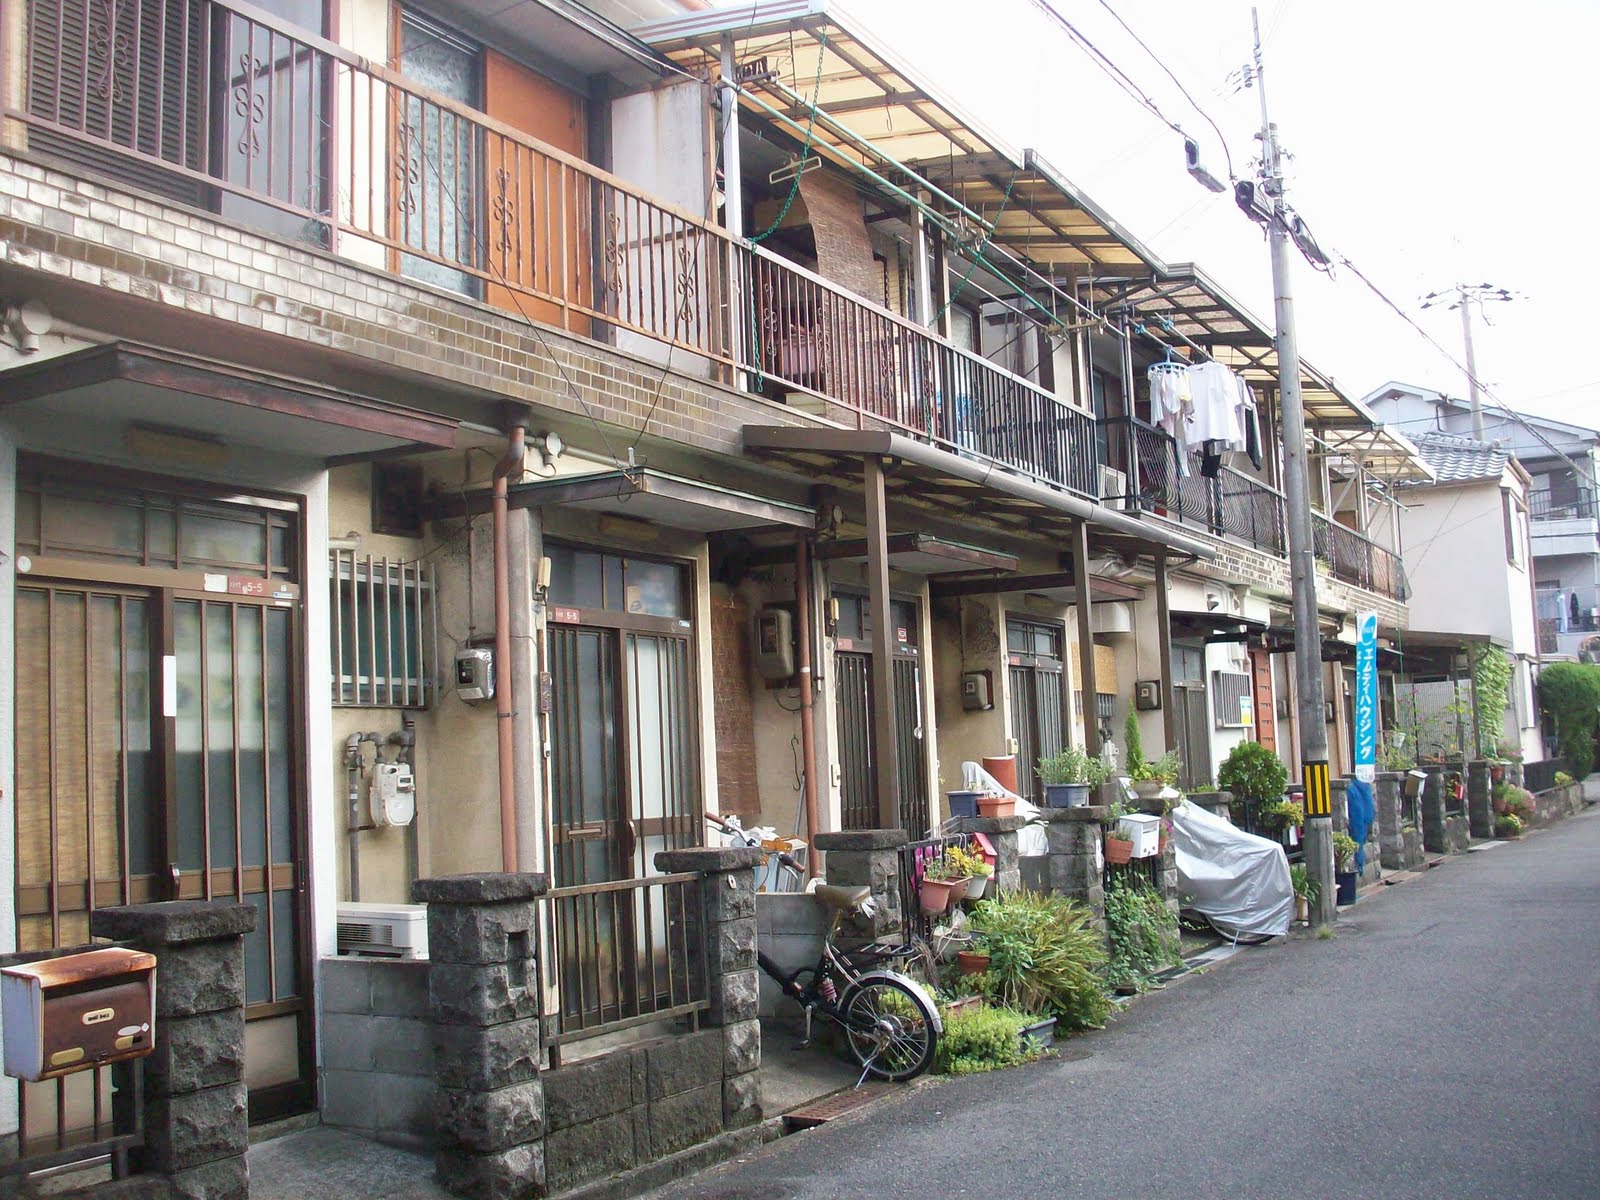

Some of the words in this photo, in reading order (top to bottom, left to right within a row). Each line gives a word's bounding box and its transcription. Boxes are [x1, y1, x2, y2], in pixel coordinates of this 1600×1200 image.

[247, 582, 263, 593] 5-5
[1360, 648, 1373, 760] エムティハウジング
